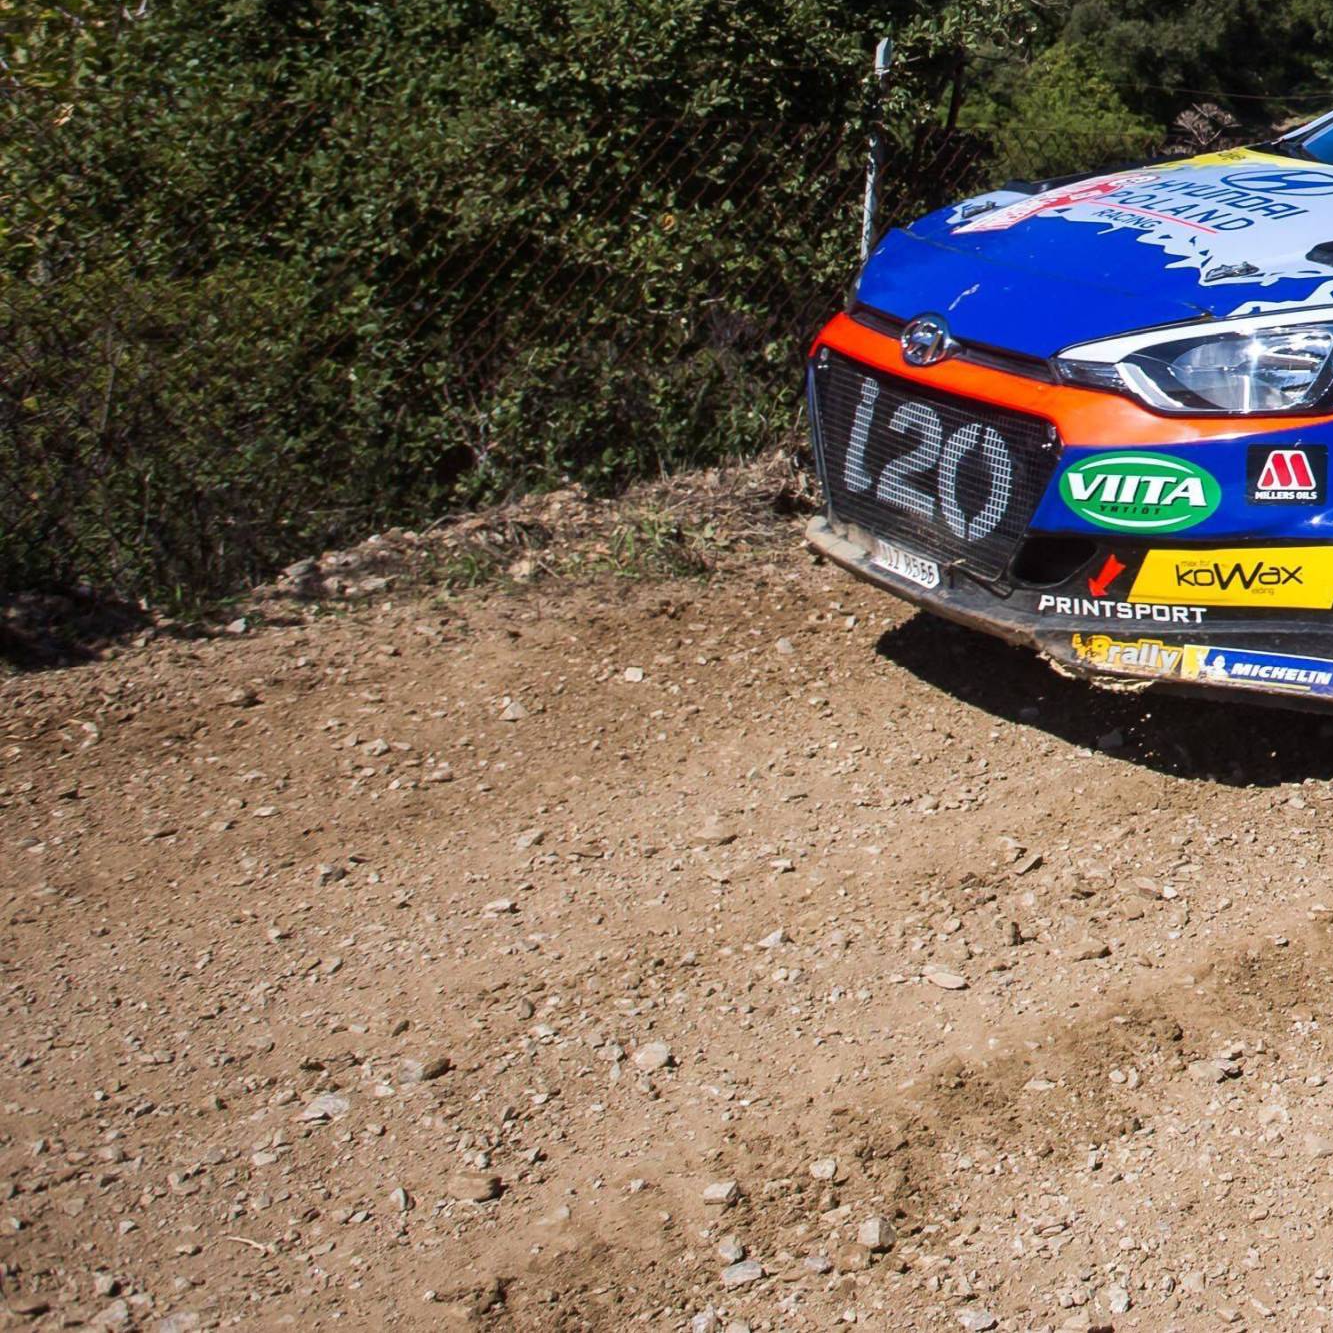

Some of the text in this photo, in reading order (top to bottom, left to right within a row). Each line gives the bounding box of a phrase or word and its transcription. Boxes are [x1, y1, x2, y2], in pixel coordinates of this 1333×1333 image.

[1099, 189, 1254, 231] POLAND
[1145, 179, 1309, 220] HYUNDAI
[1093, 207, 1163, 229] RACING
[1067, 472, 1208, 508] VIITA
[1255, 491, 1317, 499] MILLERS OILS
[1038, 594, 1207, 623] PRINTSPORT
[1231, 662, 1333, 685] MICHELIN
